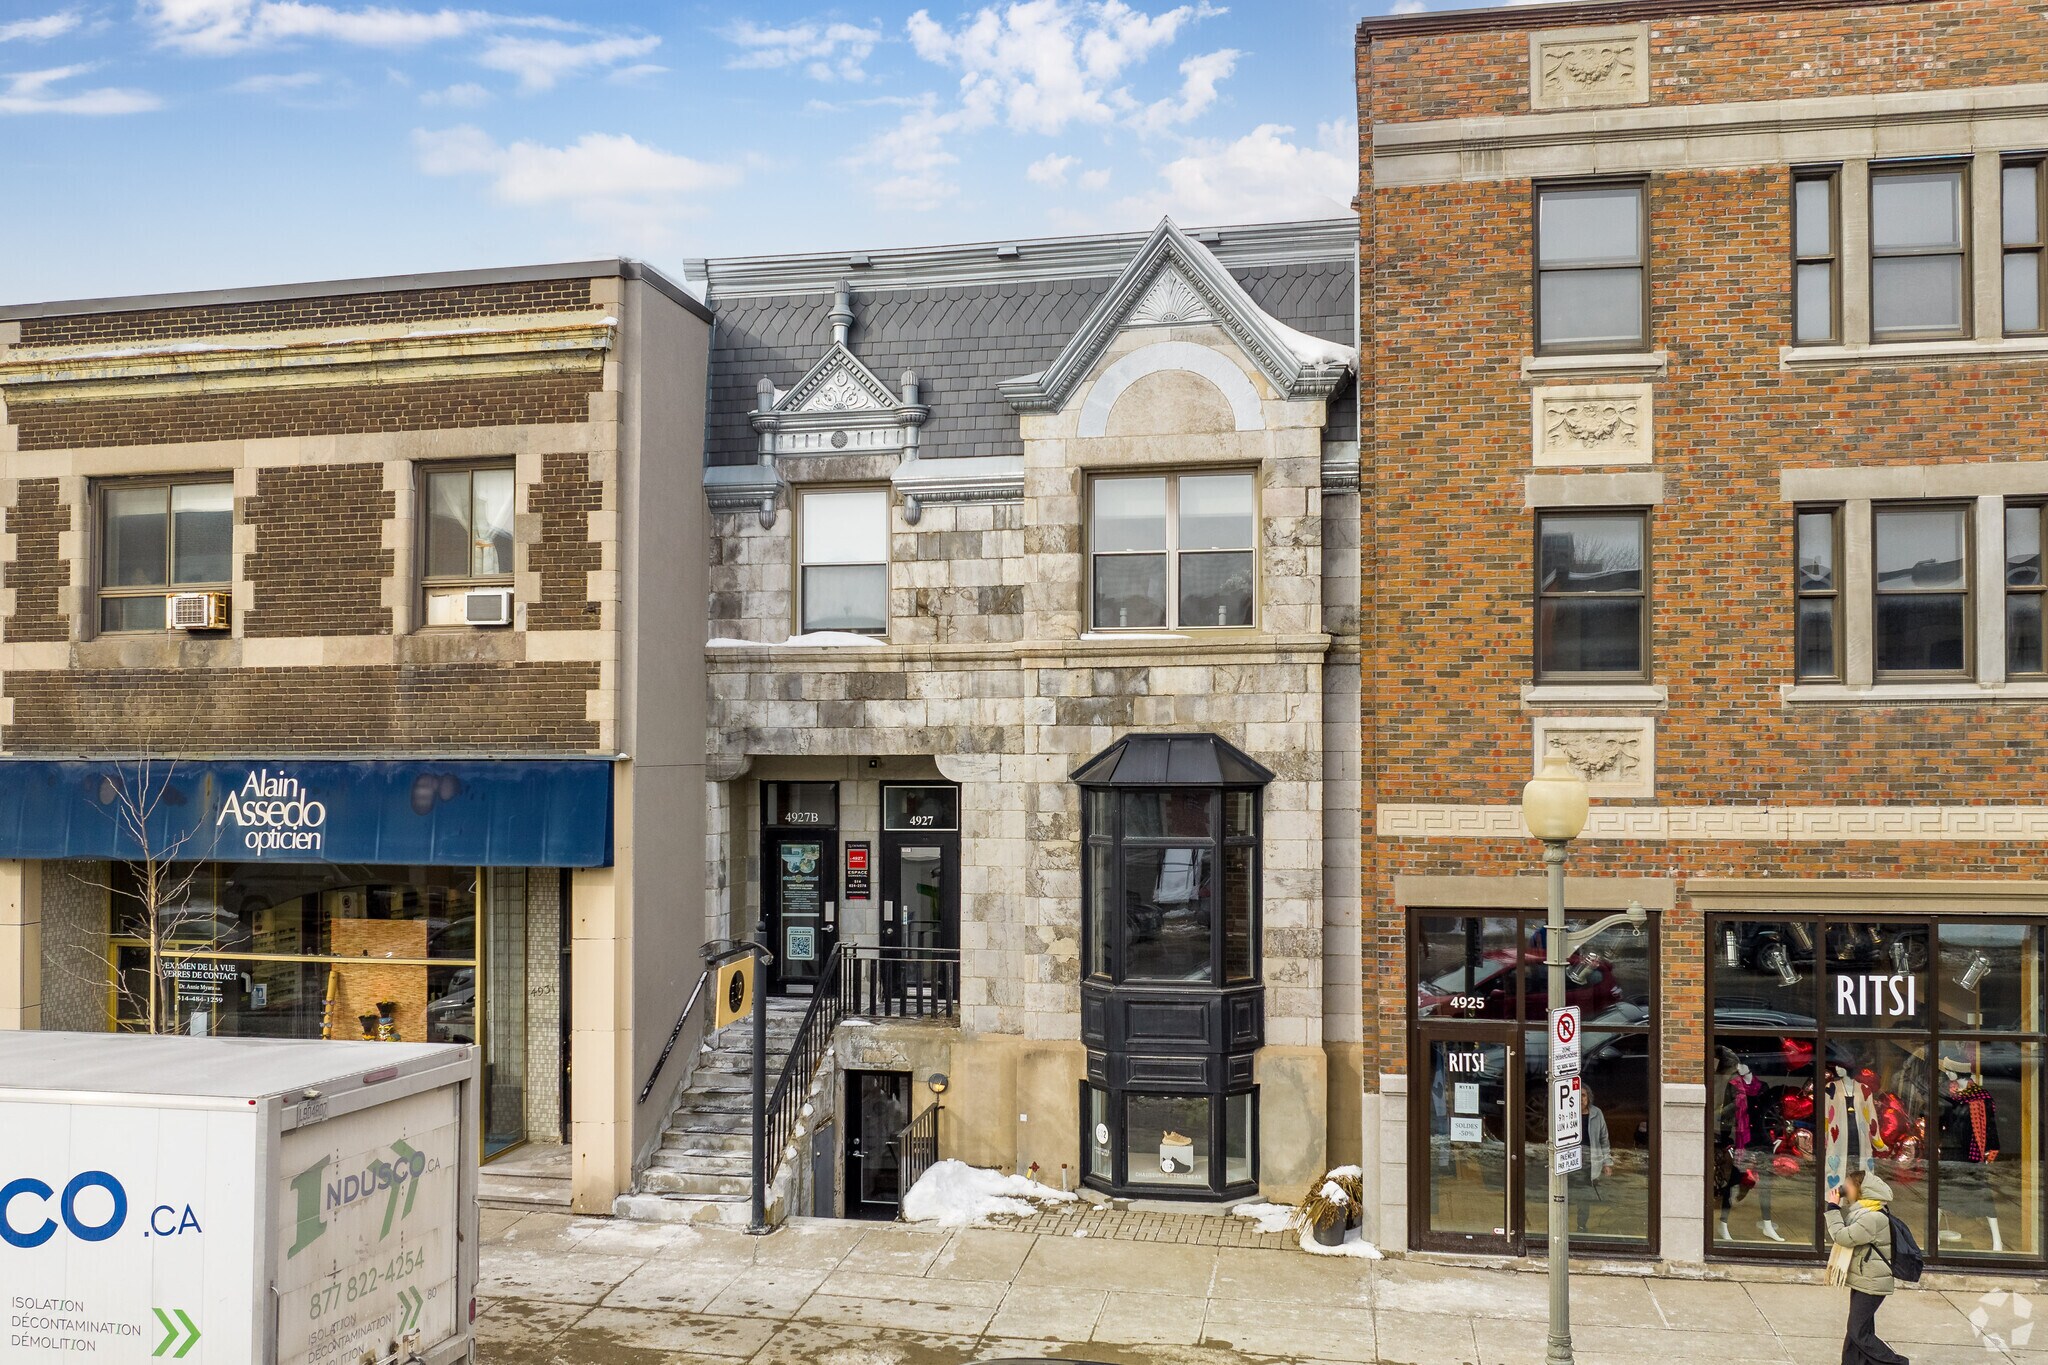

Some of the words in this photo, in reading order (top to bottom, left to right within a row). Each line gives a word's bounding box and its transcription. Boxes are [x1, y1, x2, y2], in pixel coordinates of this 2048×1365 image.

[240, 768, 298, 797] Alain
[216, 788, 326, 827] Assedo
[785, 812, 819, 823] 4927B
[909, 815, 934, 826] 4927
[245, 825, 321, 856] opticien
[163, 970, 191, 979] VERRES
[192, 971, 202, 979] DE
[203, 971, 238, 981] CONTACT
[197, 963, 208, 972] DE
[209, 964, 219, 972] LA
[220, 964, 236, 972] VUE
[530, 983, 556, 997] 4931
[1837, 974, 1915, 1016] RITSI
[1450, 996, 1485, 1009] 4925
[1449, 1052, 1485, 1072] RITSI
[144, 1203, 202, 1238] .CA
[310, 1282, 342, 1320] 877
[346, 1246, 425, 1302] 822-4254
[12, 1297, 84, 1313] ISOLATION
[11, 1312, 142, 1336] DÉCONTAMINATION
[308, 1312, 357, 1346] ISOLATION
[11, 1332, 96, 1352] DÉMOLITION
